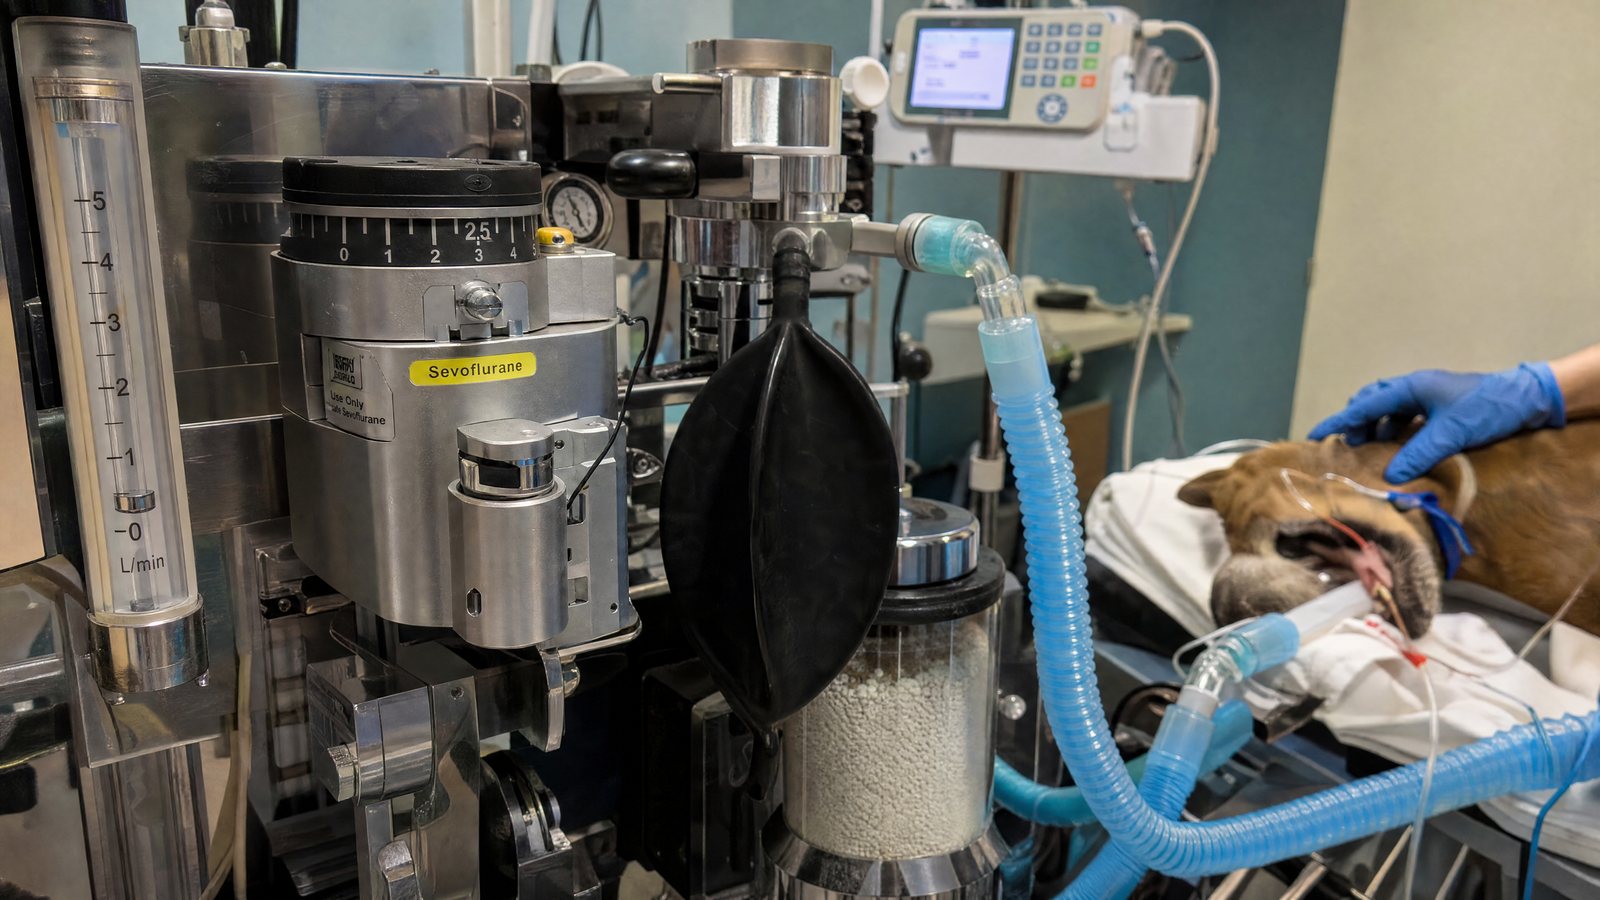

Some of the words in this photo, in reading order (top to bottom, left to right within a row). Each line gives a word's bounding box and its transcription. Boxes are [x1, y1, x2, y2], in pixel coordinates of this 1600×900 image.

[92, 191, 107, 211] 5
[99, 252, 114, 272] 4
[339, 247, 349, 262] 0
[384, 248, 393, 263] 1
[430, 249, 441, 264] 2
[474, 248, 484, 262] 3
[510, 246, 518, 260] 4
[532, 243, 537, 257] 5
[107, 313, 121, 332] 3
[428, 362, 523, 379] Sevoflurane
[115, 378, 130, 397] 2
[330, 390, 344, 403] Use
[345, 395, 364, 411] Only
[124, 447, 134, 466] 1
[128, 522, 142, 541] 0
[120, 554, 165, 573] L/min
